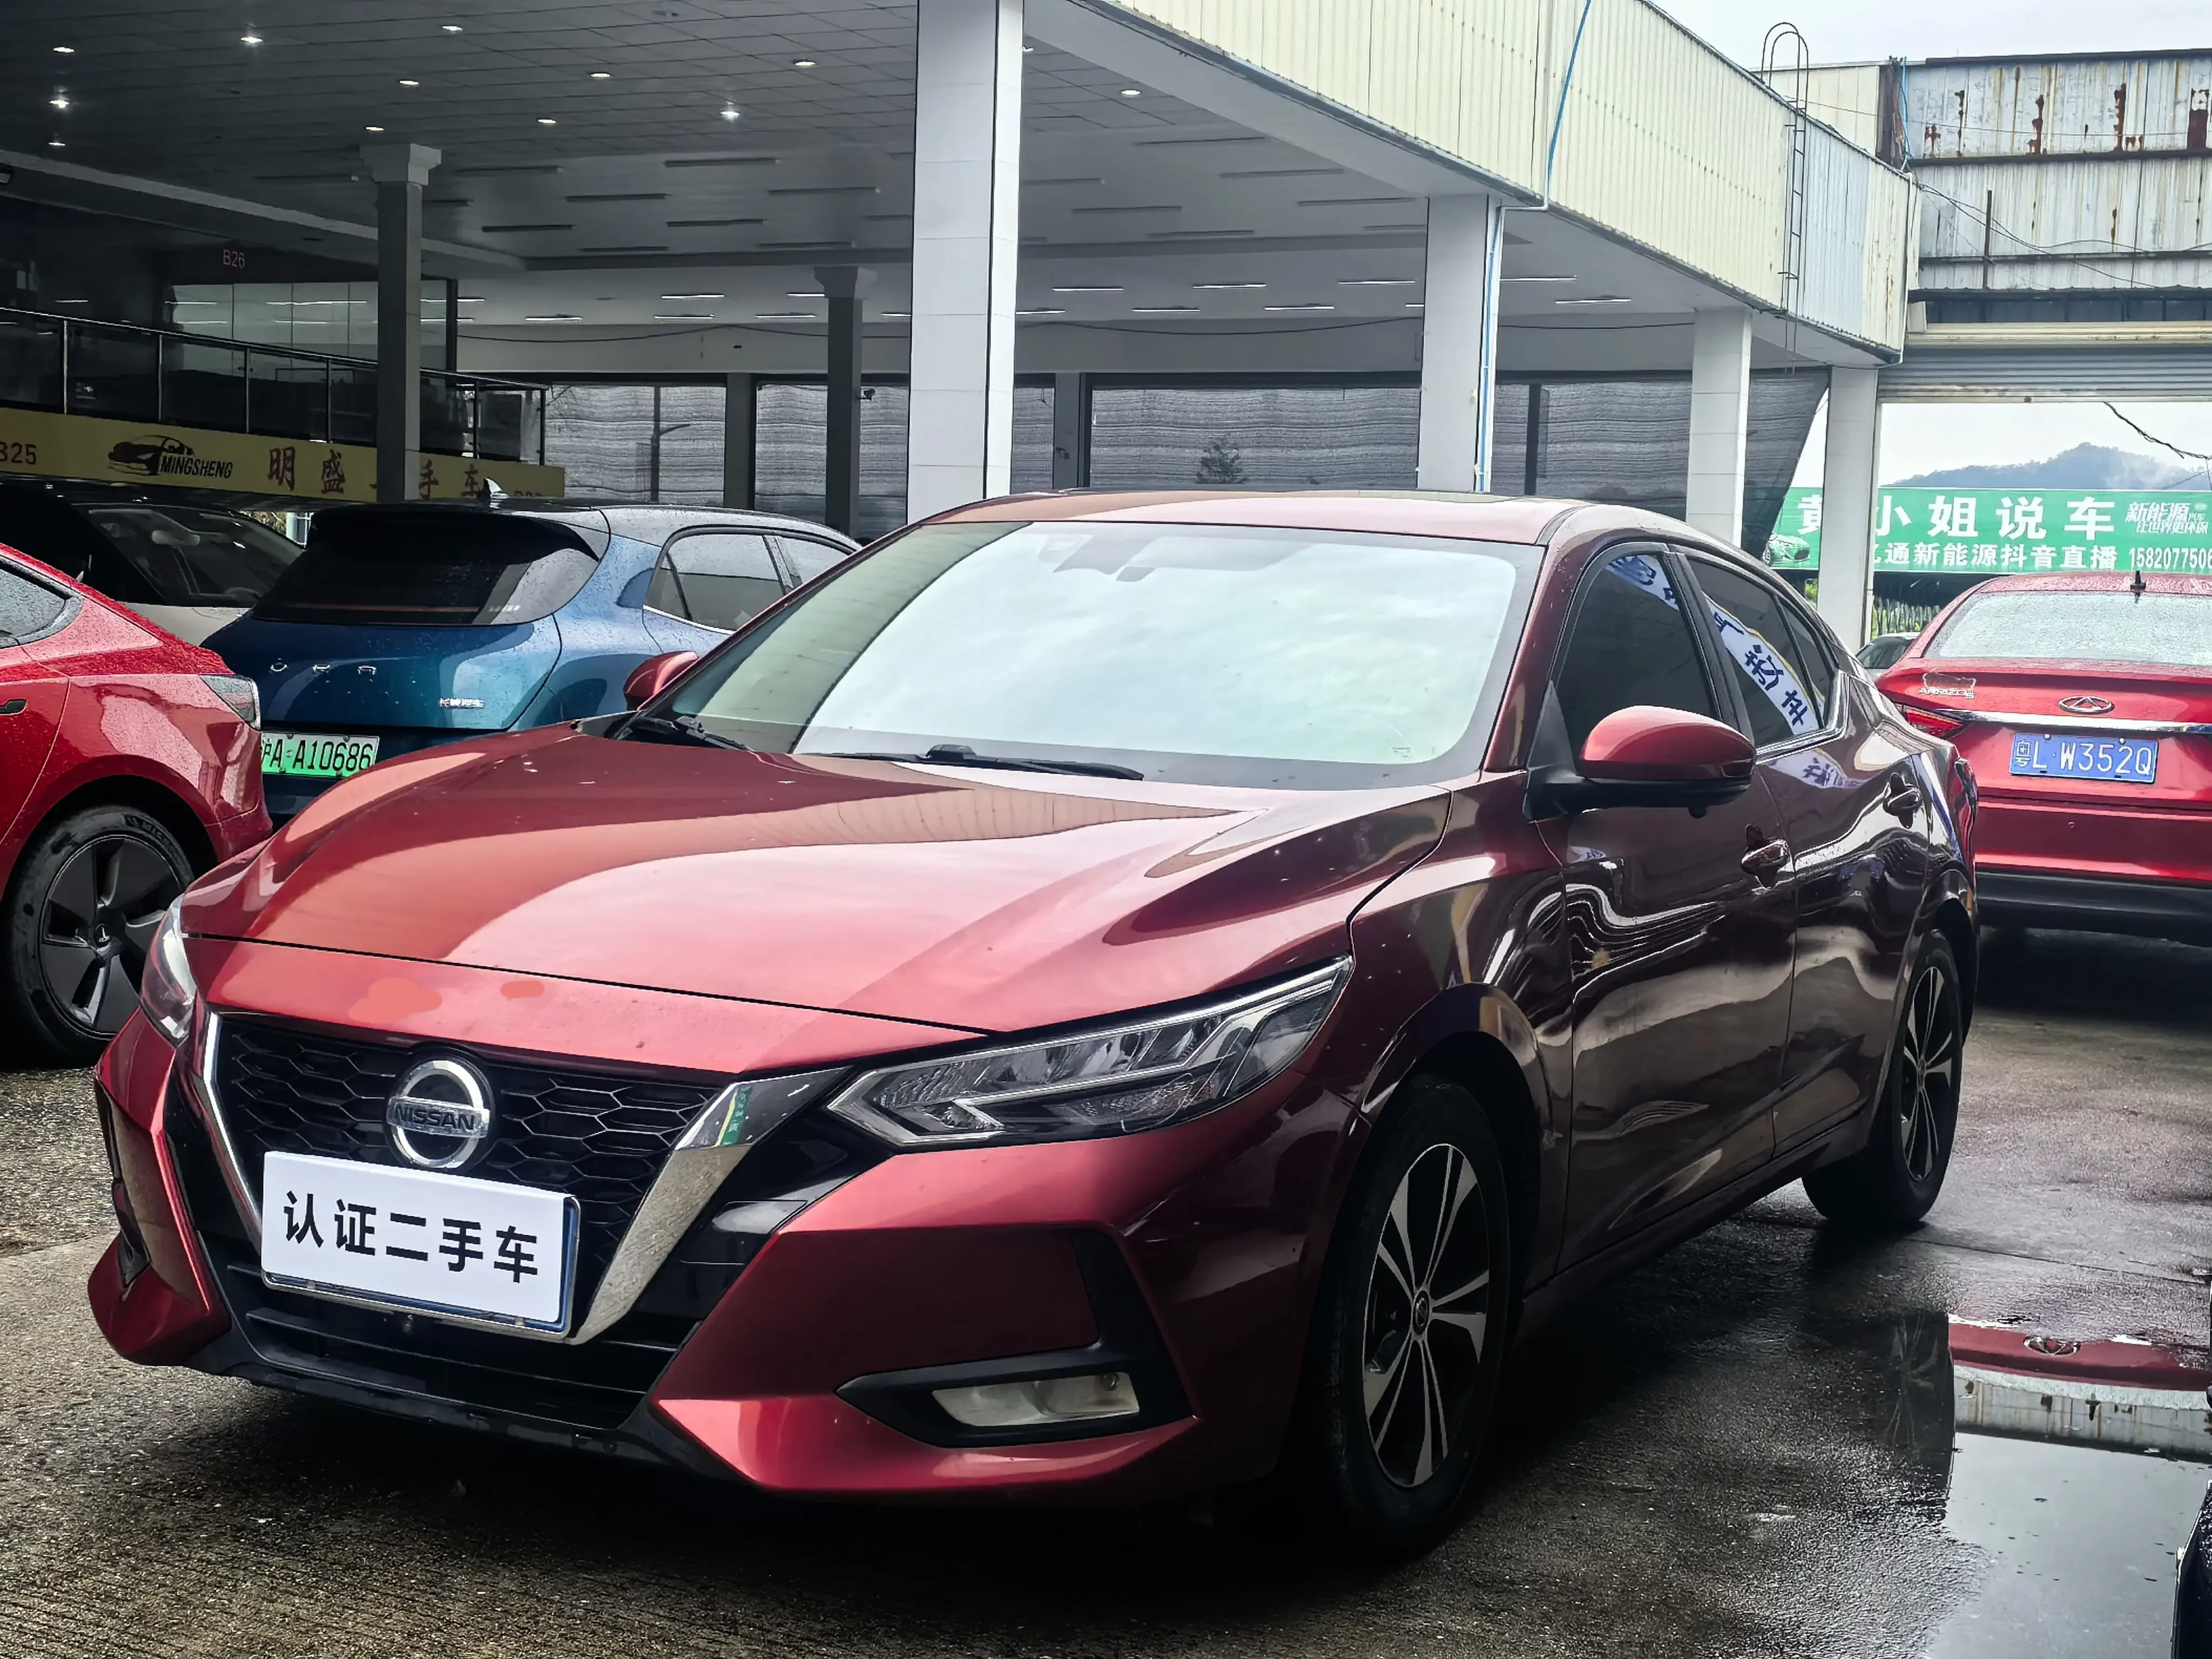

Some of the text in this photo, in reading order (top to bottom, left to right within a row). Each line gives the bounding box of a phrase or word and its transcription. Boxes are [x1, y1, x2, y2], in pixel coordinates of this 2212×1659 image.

[223, 249, 245, 269] B26
[161, 455, 233, 478] MINGSHENG
[267, 446, 481, 501] 明盛手车
[1873, 541, 2119, 570] 通新能源抖音直播
[395, 1103, 476, 1130] NISSAN
[284, 1190, 538, 1284] 认证二手车
